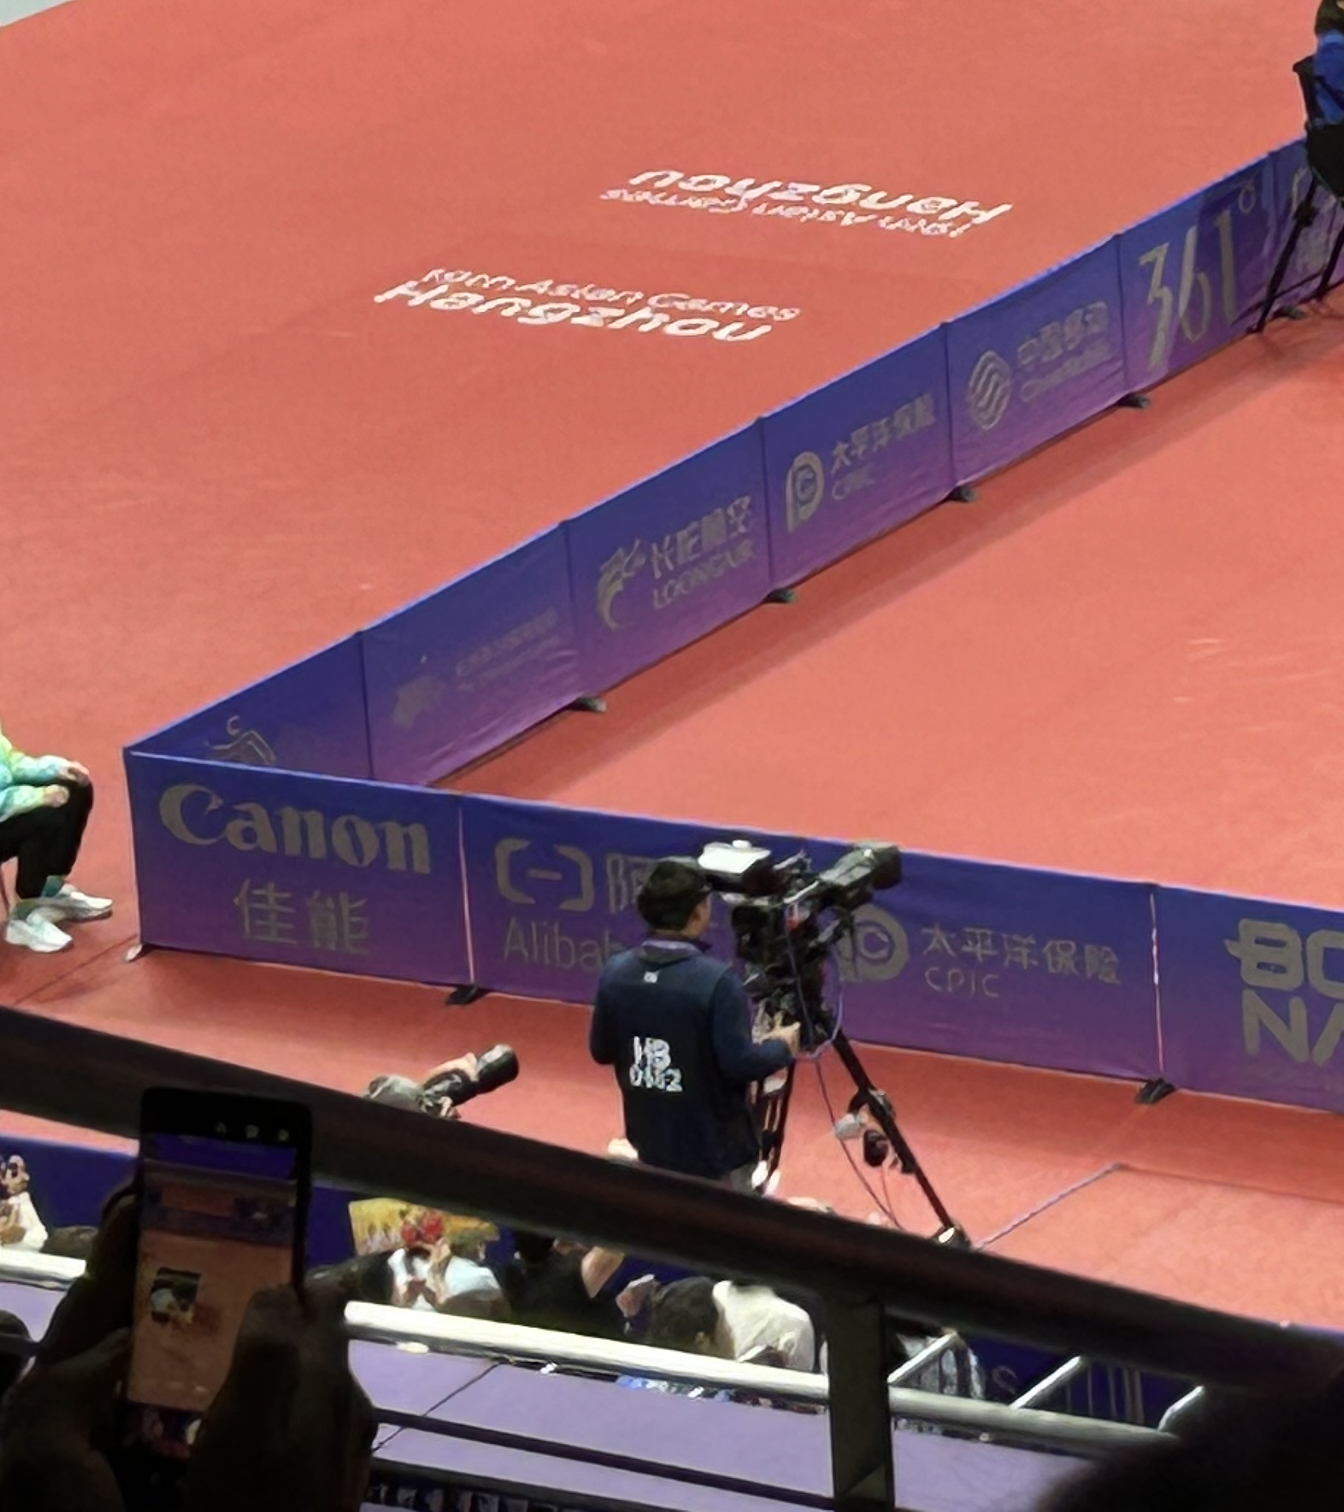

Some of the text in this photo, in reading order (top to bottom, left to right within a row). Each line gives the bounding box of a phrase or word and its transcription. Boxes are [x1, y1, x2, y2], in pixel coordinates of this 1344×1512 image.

[374, 279, 773, 343] Hangzhou
[158, 784, 431, 876] Canon
[232, 879, 370, 956] 佳能
[920, 922, 1121, 986] 太平洋保险
[924, 965, 1001, 998] CPIC
